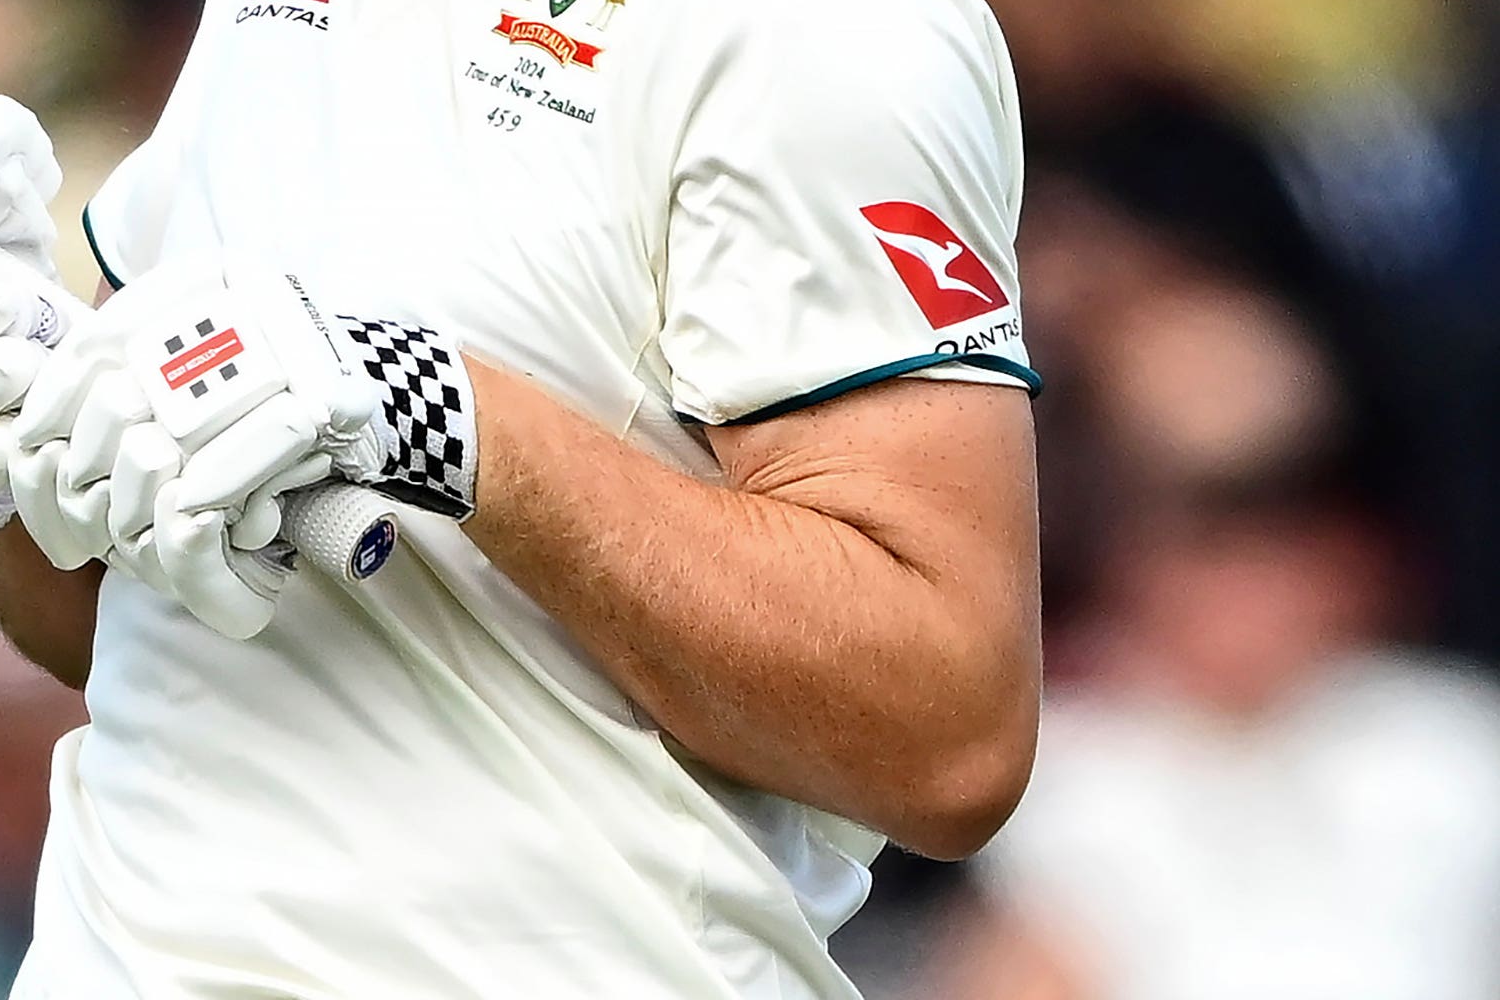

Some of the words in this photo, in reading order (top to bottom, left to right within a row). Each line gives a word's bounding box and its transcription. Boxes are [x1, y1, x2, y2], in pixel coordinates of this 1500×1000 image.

[510, 24, 570, 63] AUSTRALIA
[514, 56, 545, 80] 2024
[465, 61, 489, 81] Tour
[490, 74, 507, 88] of
[505, 78, 536, 98] New
[537, 90, 596, 124] Zealand
[487, 107, 521, 132] 459
